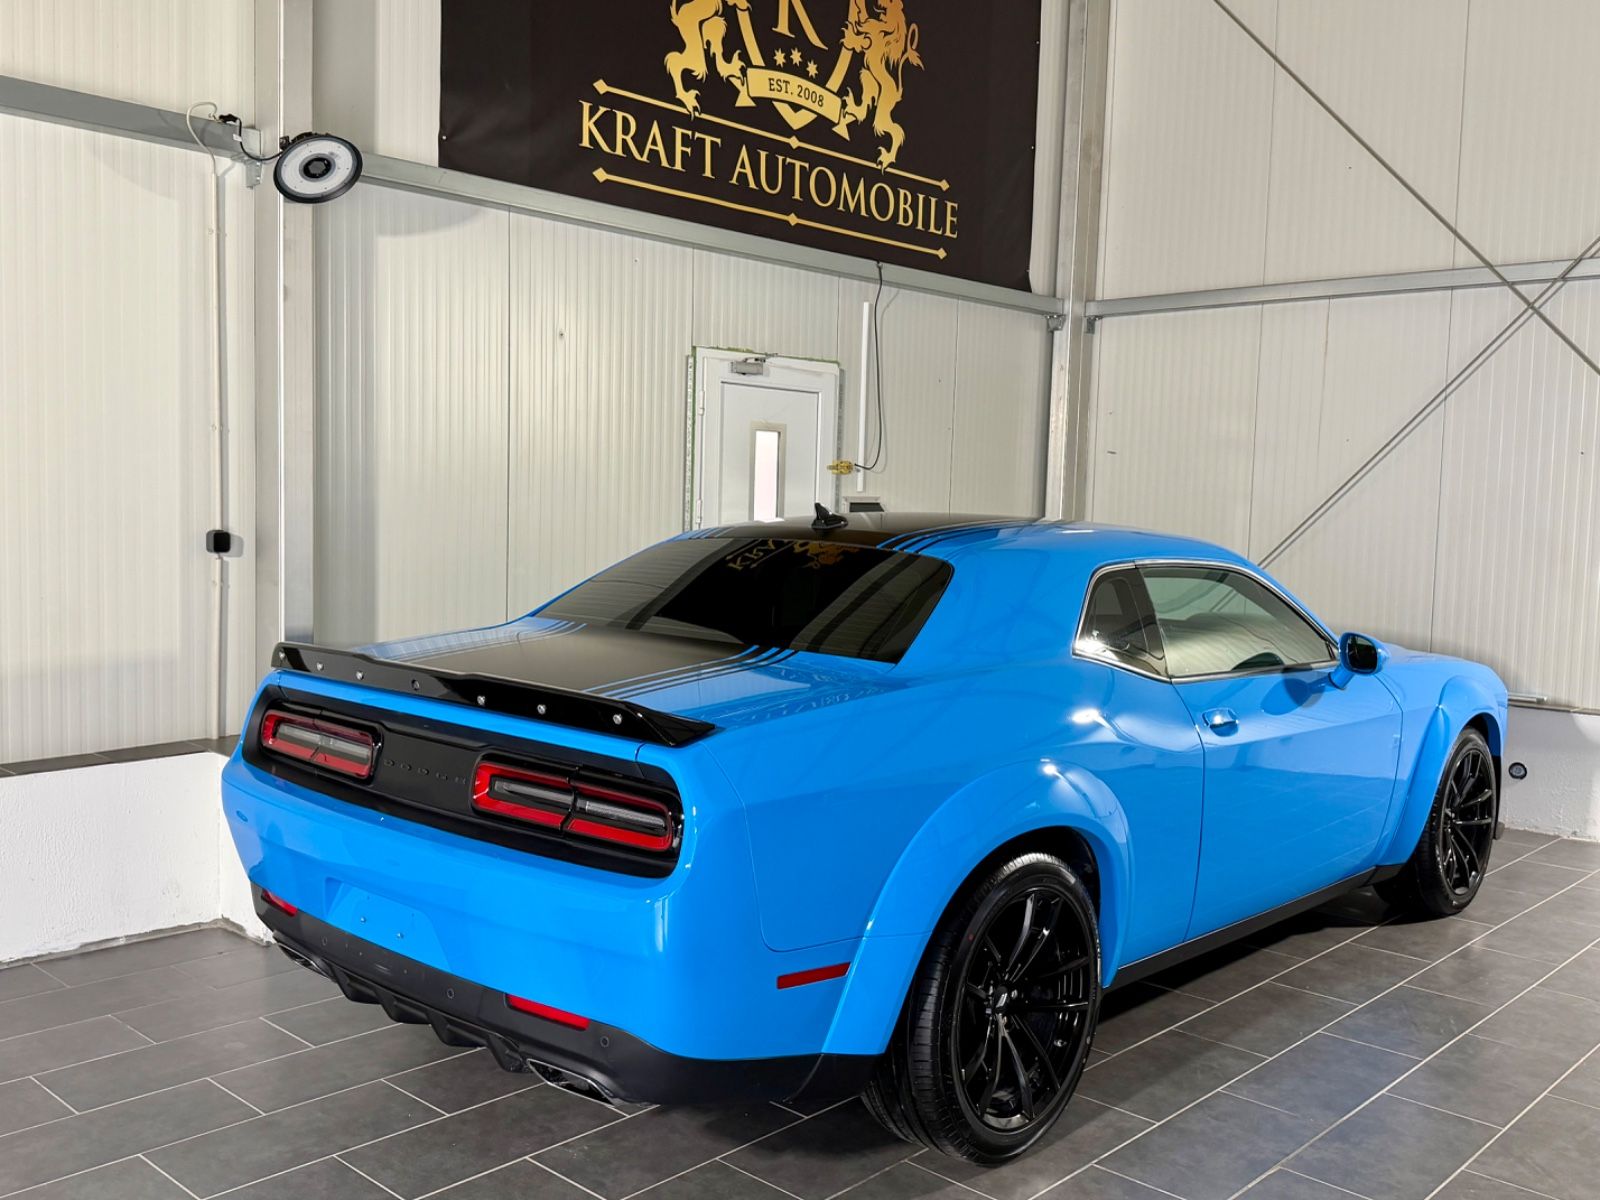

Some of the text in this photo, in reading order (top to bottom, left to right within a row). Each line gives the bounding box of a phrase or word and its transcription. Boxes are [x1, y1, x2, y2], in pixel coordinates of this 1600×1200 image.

[768, 77, 825, 107] EST. 2008
[578, 99, 959, 239] KRAFT AUTOMOBILE
